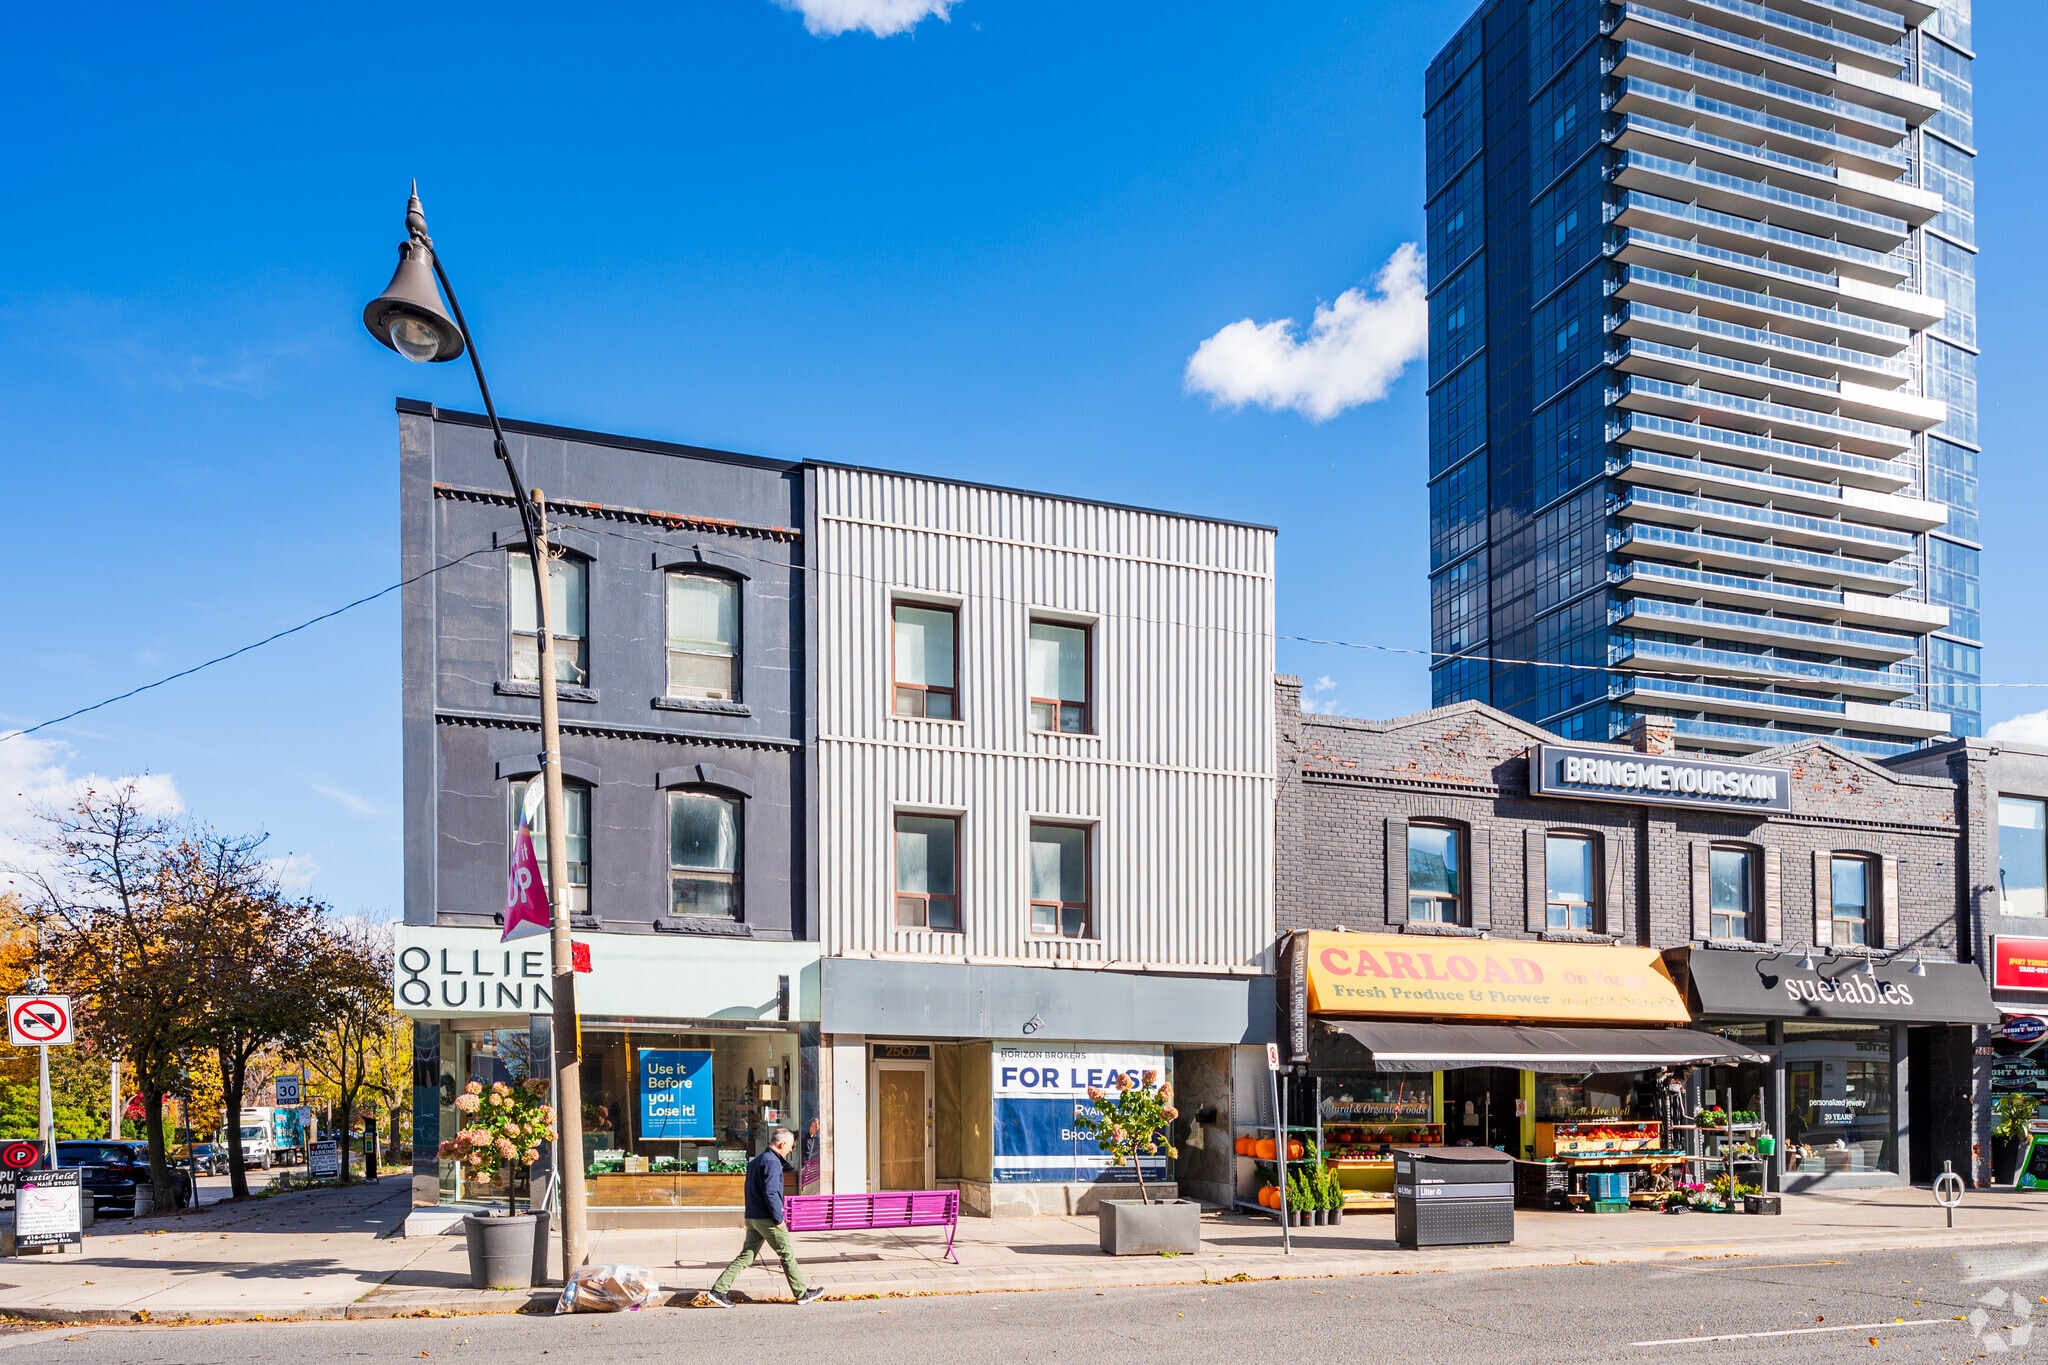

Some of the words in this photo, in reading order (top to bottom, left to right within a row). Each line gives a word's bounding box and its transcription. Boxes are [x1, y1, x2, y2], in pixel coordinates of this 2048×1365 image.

[1563, 755, 1777, 800] BRINGMEYOURSKIN
[508, 866, 532, 907] UP
[399, 946, 544, 979] OLLIE
[1295, 950, 1304, 984] NATURAL
[1319, 948, 1544, 985] CARLOAD
[1563, 970, 1589, 985] On
[1592, 972, 1647, 989] Yonge
[1334, 983, 1388, 999] Fresh
[1392, 986, 1465, 1002] Produce
[1469, 989, 1484, 1001] &
[1490, 989, 1550, 1005] Flower
[1785, 974, 1914, 1006] suetables
[1295, 993, 1304, 1028] ORGANIC
[2027, 1025, 2047, 1033] WING
[1295, 1028, 1304, 1053] FOODS
[886, 1046, 918, 1058] 2507
[1001, 1050, 1043, 1059] HORIZON
[1045, 1051, 1087, 1060] BROKERS
[648, 1063, 674, 1075] Use
[676, 1063, 687, 1075] it
[648, 1077, 693, 1089] Before
[1002, 1067, 1060, 1089] FOR
[279, 1085, 297, 1097] 30
[648, 1093, 675, 1105] you
[1809, 1099, 1846, 1107] personalized
[1845, 1099, 1867, 1108] jewelry
[648, 1104, 680, 1117] Lose
[682, 1104, 696, 1117] it!
[1322, 1104, 1353, 1115] atural
[1353, 1104, 1362, 1113] &
[1363, 1104, 1396, 1116] Organic
[1399, 1104, 1427, 1115] Foods
[1590, 1106, 1609, 1116] Live
[1610, 1105, 1631, 1116] Well
[1824, 1113, 1832, 1121] 20
[1833, 1113, 1853, 1121] YEARS
[20, 1171, 77, 1182] Castlefield
[1401, 1186, 1412, 1195] Litter
[1420, 1187, 1436, 1196] Litter
